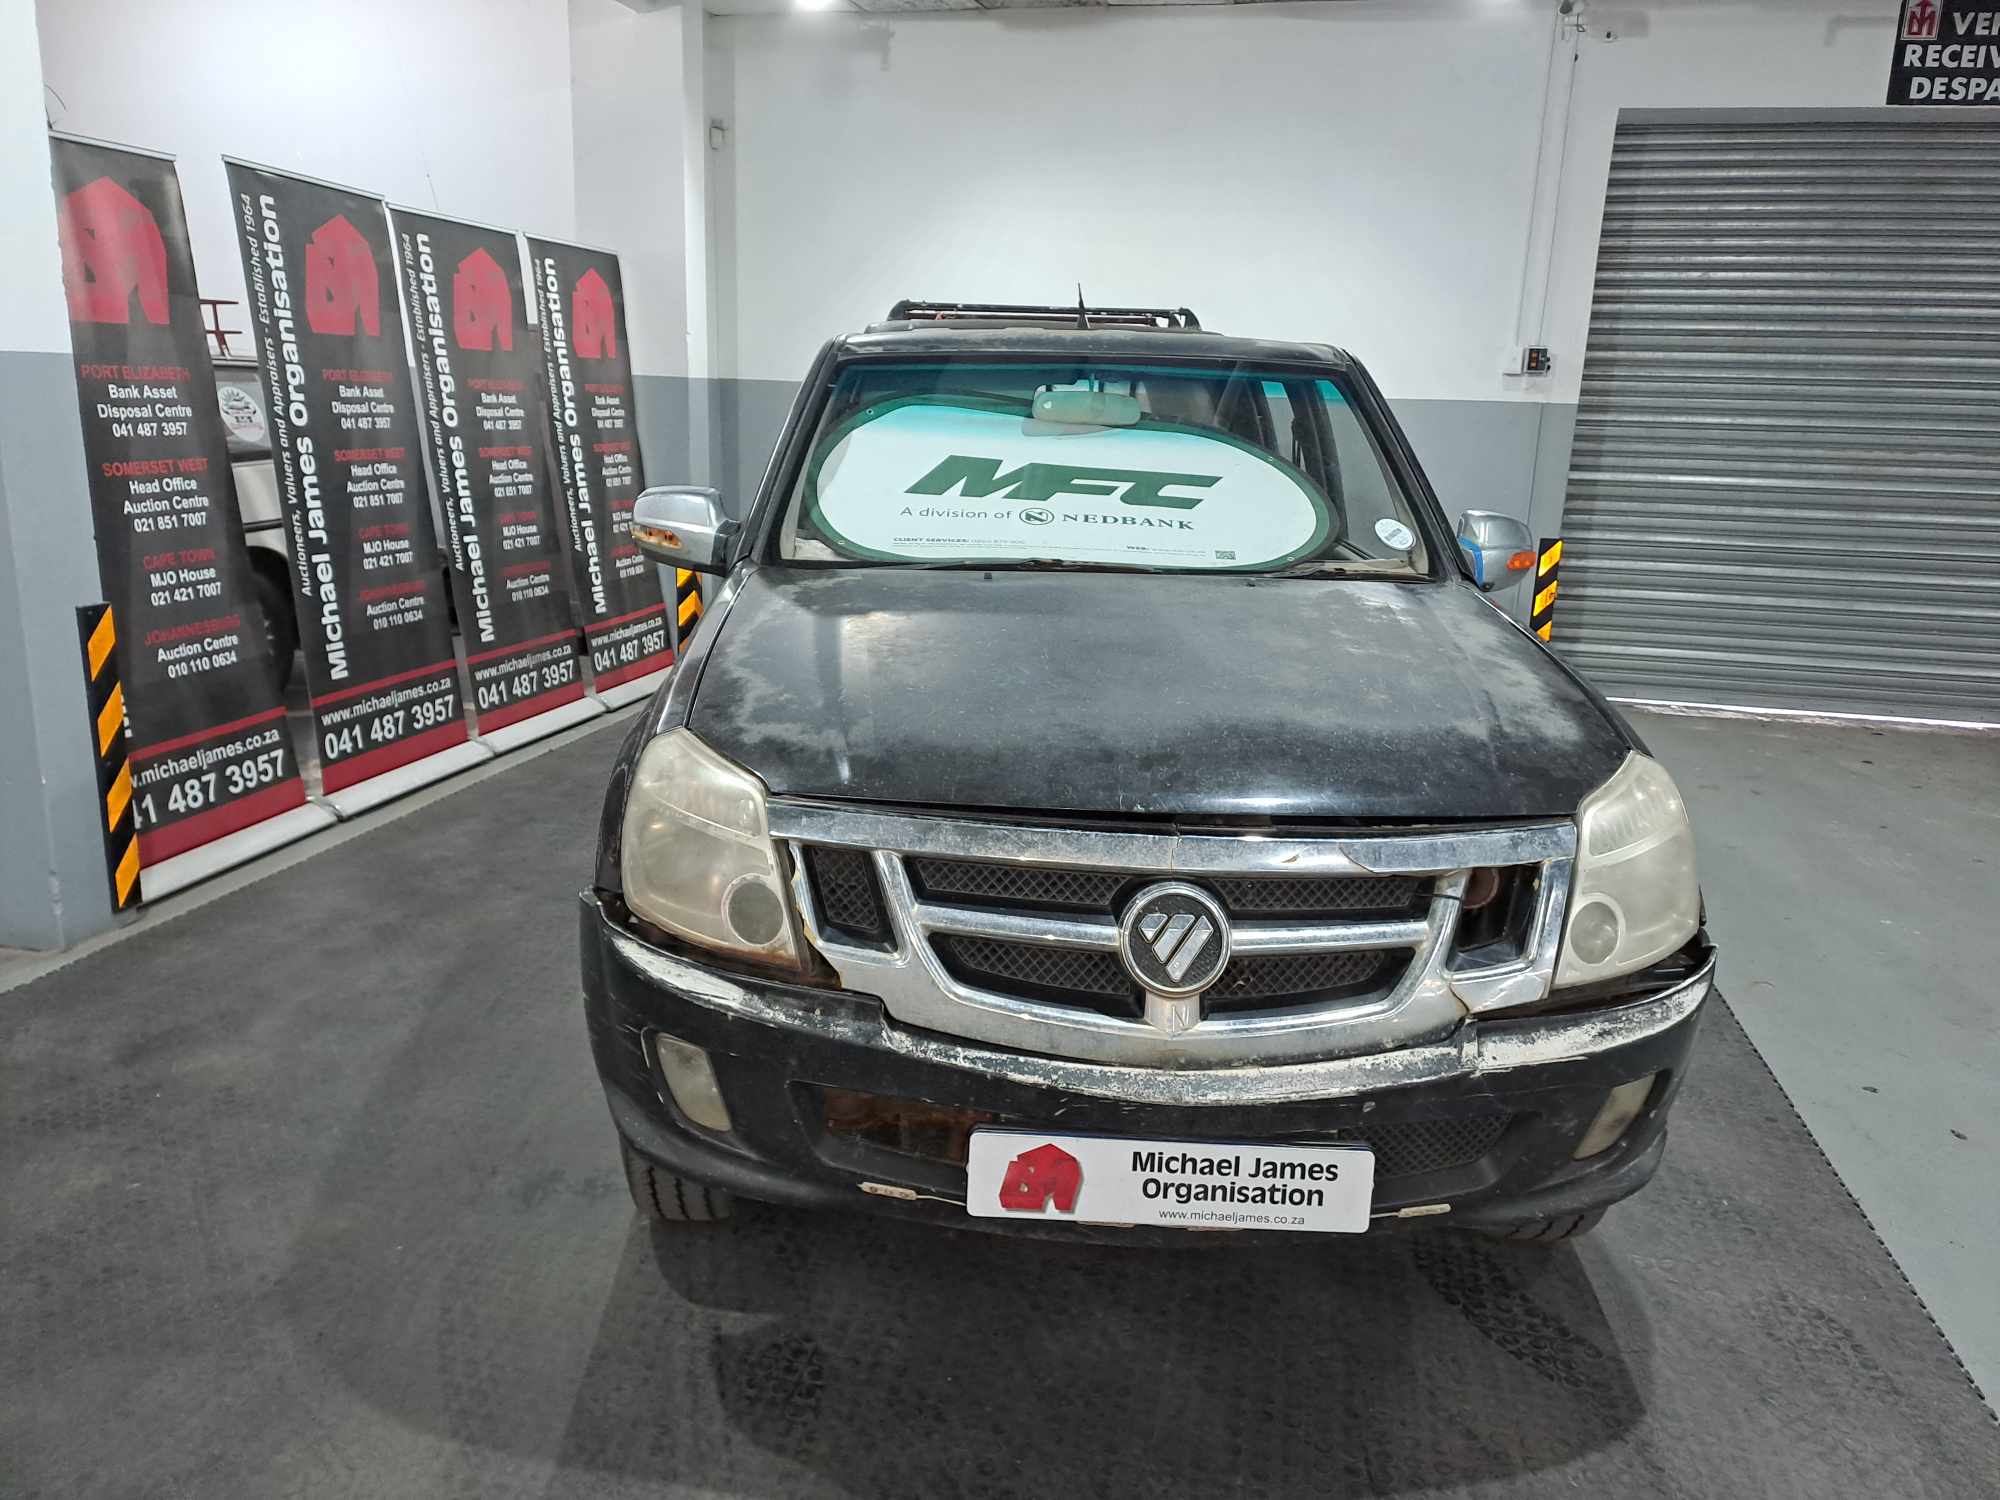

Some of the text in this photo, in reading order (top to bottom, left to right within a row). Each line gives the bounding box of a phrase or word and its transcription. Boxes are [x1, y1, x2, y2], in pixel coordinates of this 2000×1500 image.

[1909, 77, 2000, 100] DESPA
[80, 364, 119, 379] PORT
[108, 384, 178, 399] Bank Asset
[241, 193, 313, 598] Auctioneers, Valuers and Appraisers Established 1964
[97, 403, 192, 421] Disposal Centre
[331, 401, 369, 416] Disposal
[112, 422, 187, 437] 041 487 3957
[260, 194, 349, 680] Michael James Organisation
[416, 233, 495, 643] Michael James Organisation
[544, 257, 608, 615] Michael James Organisation
[102, 459, 174, 476] SOMERSET
[129, 477, 197, 495] Head Office
[347, 480, 379, 493] Auction
[904, 454, 1223, 510] MFC
[124, 495, 209, 515] Auction Centre
[134, 512, 207, 532] 021 851 7007
[900, 506, 913, 517] A
[919, 506, 988, 519] division
[994, 510, 1013, 519] of
[1063, 513, 1195, 530] NEDBANK
[150, 568, 216, 587] MJO House
[150, 582, 221, 606] 021 421 7007
[367, 600, 398, 616] Auction
[157, 634, 239, 662] Auction Centre
[594, 630, 665, 672] 041 487 3957
[168, 650, 237, 679] 010 110 0634
[478, 659, 574, 709] 041 487 3957
[321, 677, 451, 726] www.michaeljames.co.za
[325, 694, 454, 759] 041 487 3957
[168, 772, 216, 813] 487
[225, 749, 284, 794] 3957
[1131, 1151, 1339, 1182] Michael James
[1142, 1178, 1325, 1207] Organisation
[1159, 1210, 1305, 1225] www.michaeljames.co.za
